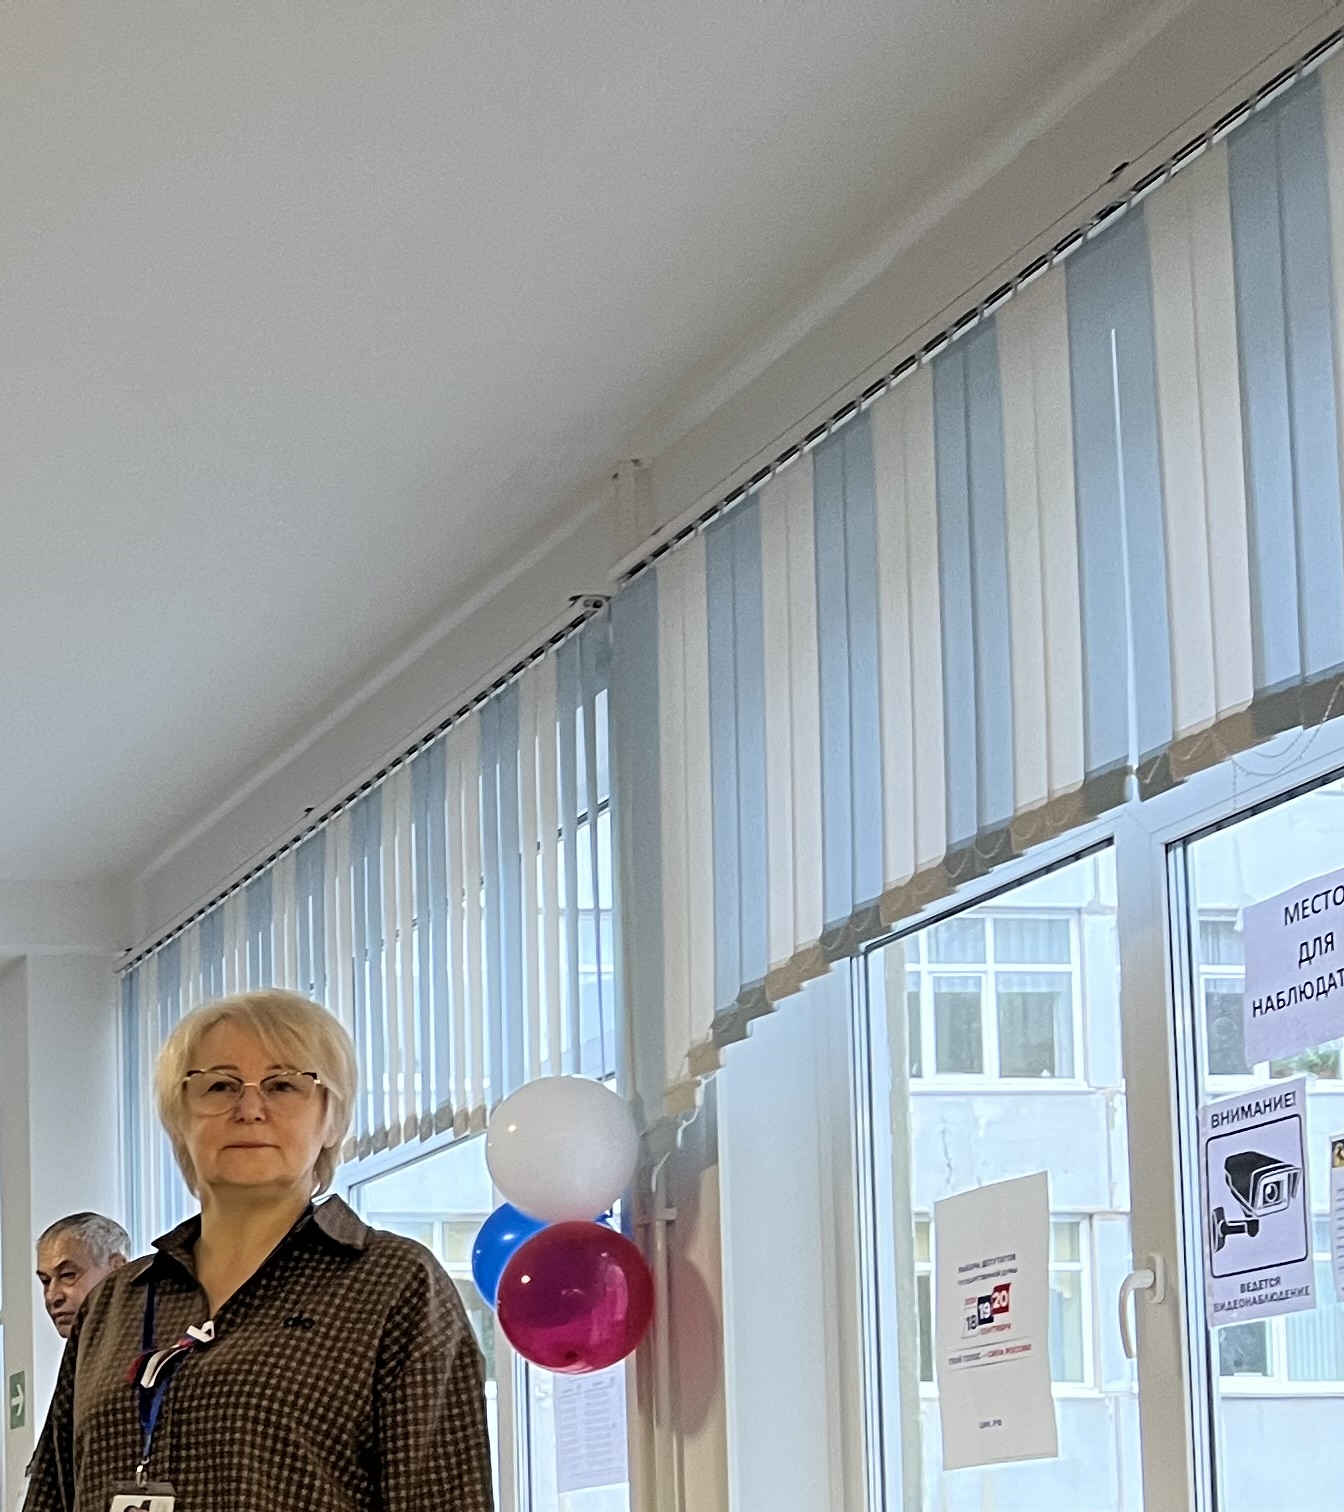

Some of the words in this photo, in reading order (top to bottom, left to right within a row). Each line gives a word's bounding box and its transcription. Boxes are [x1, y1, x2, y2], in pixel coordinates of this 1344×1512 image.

[1283, 884, 1344, 927] МЕСТО
[1298, 931, 1335, 970] ДЛЯ
[1211, 1090, 1297, 1129] ВНИМАНИЕ!
[1213, 1285, 1311, 1313] ВИДЕОНАБЛЮДЕНИЕ
[1240, 1276, 1282, 1294] ВЕДЕТСЯ
[966, 1314, 978, 1332] 18
[978, 1301, 991, 1320] 19
[992, 1290, 1009, 1309] 20
